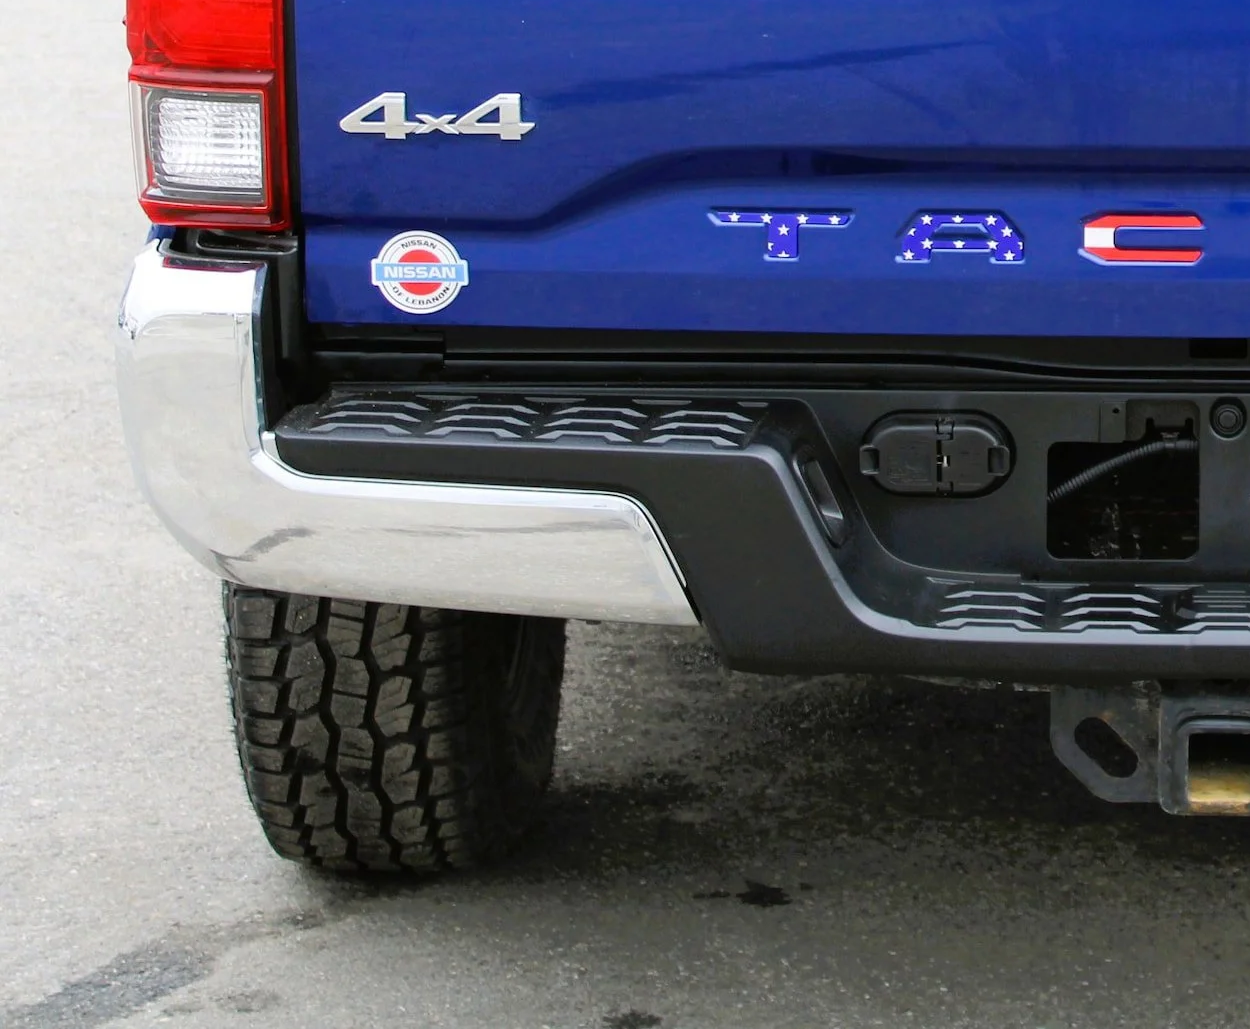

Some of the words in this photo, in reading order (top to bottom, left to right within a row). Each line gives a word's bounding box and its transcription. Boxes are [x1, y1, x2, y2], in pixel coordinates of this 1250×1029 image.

[339, 91, 535, 140] 4x4
[401, 239, 437, 249] NISSAN
[384, 266, 456, 279] NISSAN
[392, 286, 403, 297] OF
[405, 286, 450, 305] LEBANON
